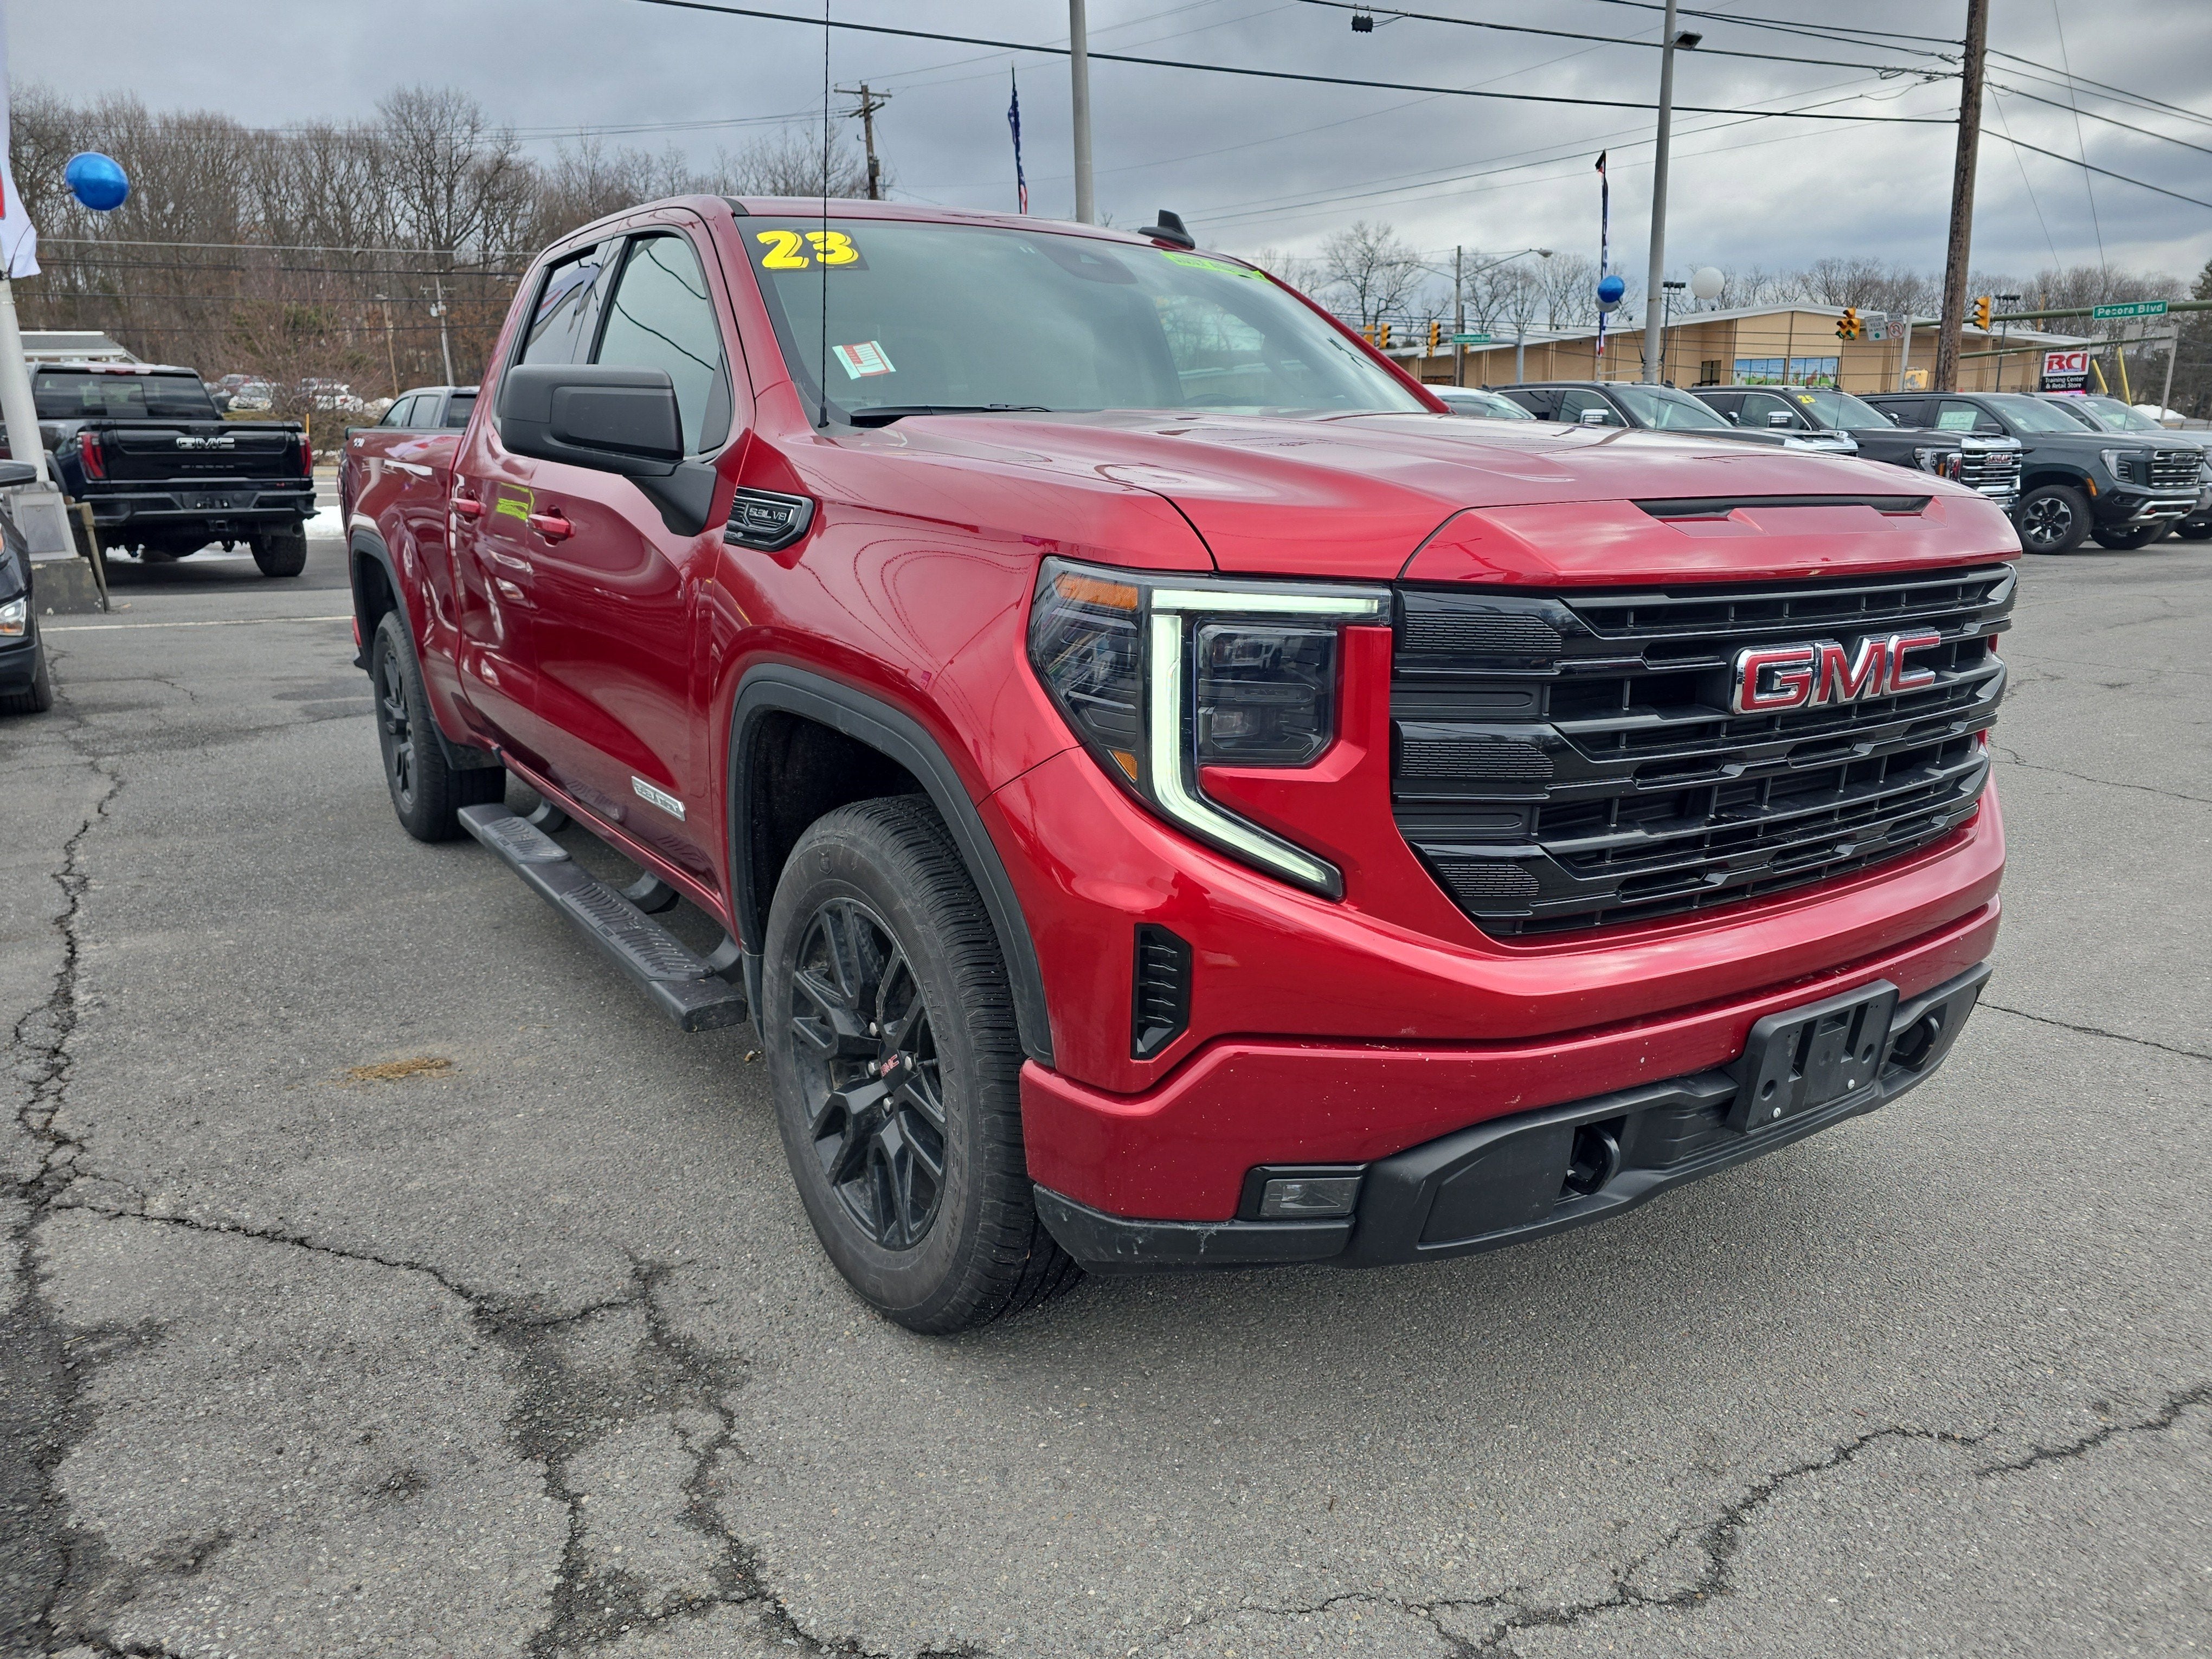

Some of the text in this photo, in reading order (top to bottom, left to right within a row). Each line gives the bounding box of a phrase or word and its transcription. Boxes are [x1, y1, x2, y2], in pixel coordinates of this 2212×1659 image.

[756, 230, 859, 269] 23
[2098, 304, 2163, 316] Pecora Blvd
[1797, 395, 1816, 404] 25
[176, 437, 235, 449] GMC
[773, 511, 787, 521] V8
[1733, 630, 1941, 715] GMC
[880, 1053, 900, 1077] GMC
